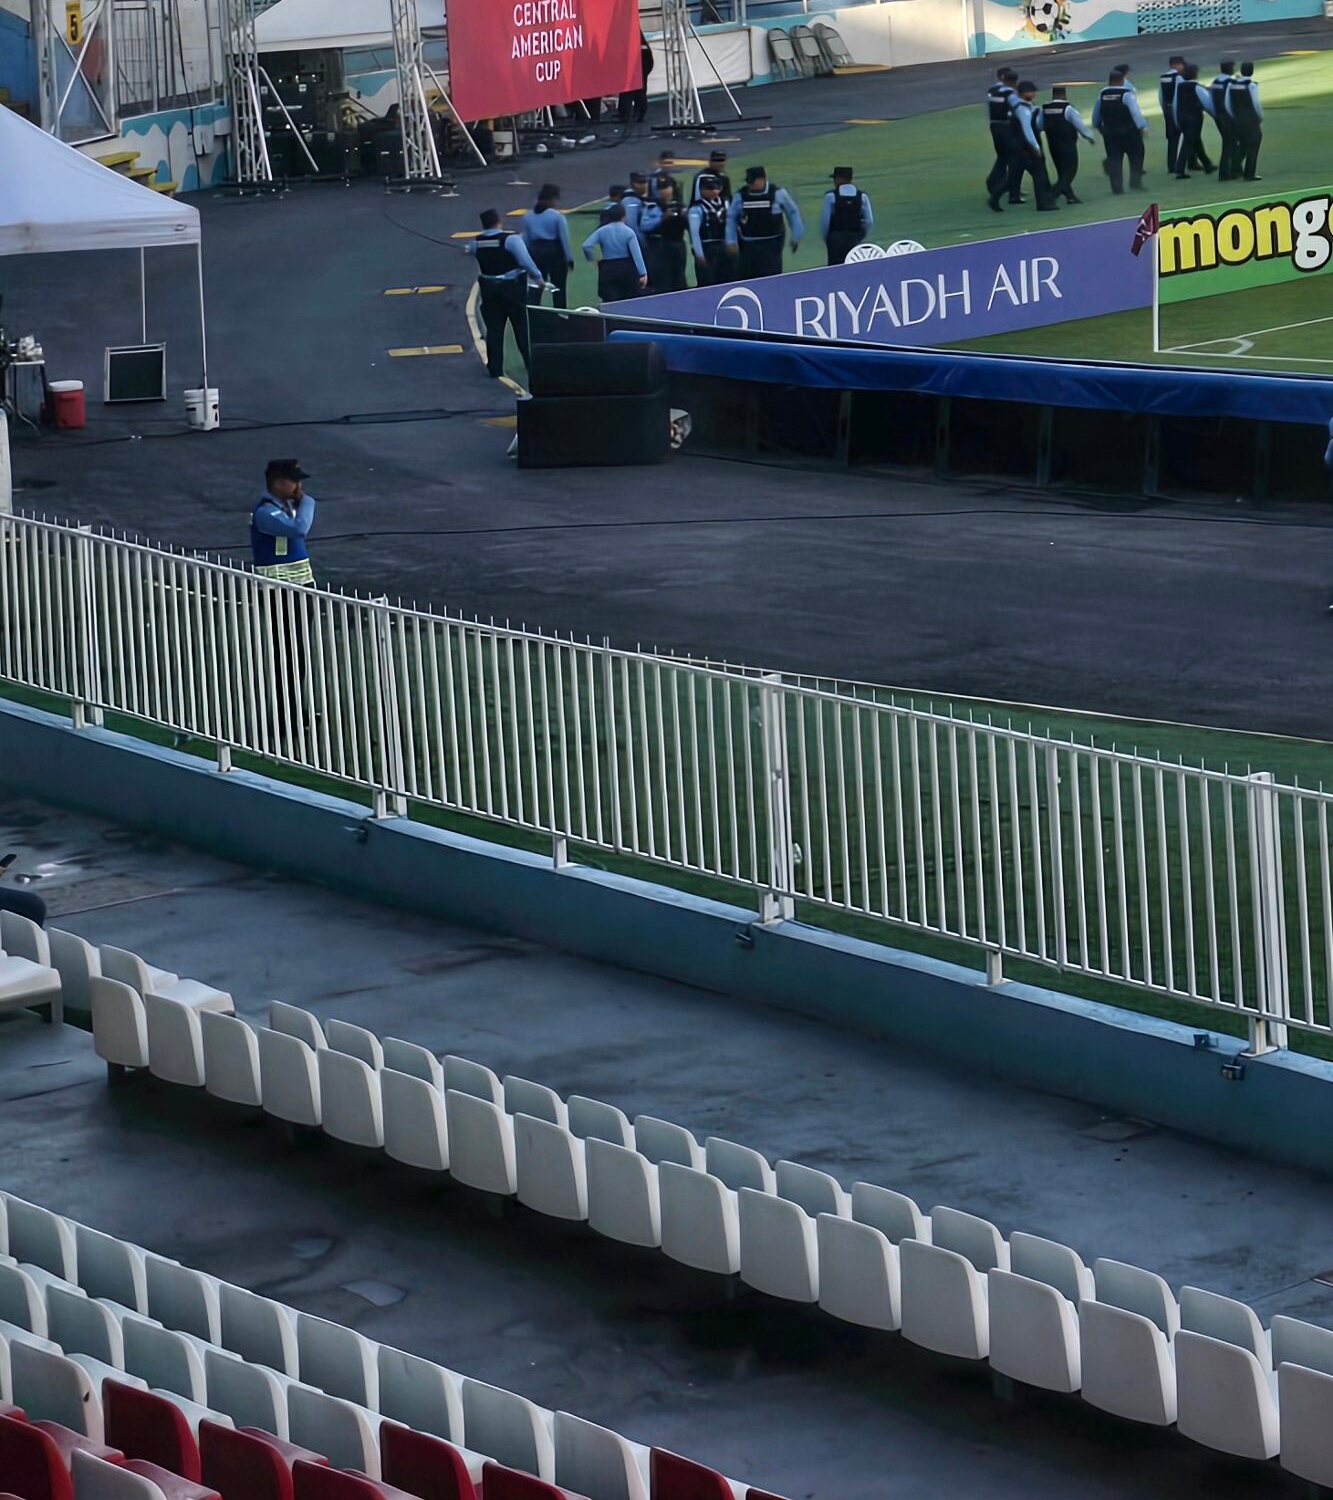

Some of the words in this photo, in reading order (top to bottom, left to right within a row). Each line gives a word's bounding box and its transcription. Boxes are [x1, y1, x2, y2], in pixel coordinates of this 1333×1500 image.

[70, 13, 78, 42] 5
[511, 24, 583, 59] AMERICAN
[535, 59, 561, 82] CUP
[795, 269, 972, 340] RIYADH
[987, 256, 1063, 312] AIR
